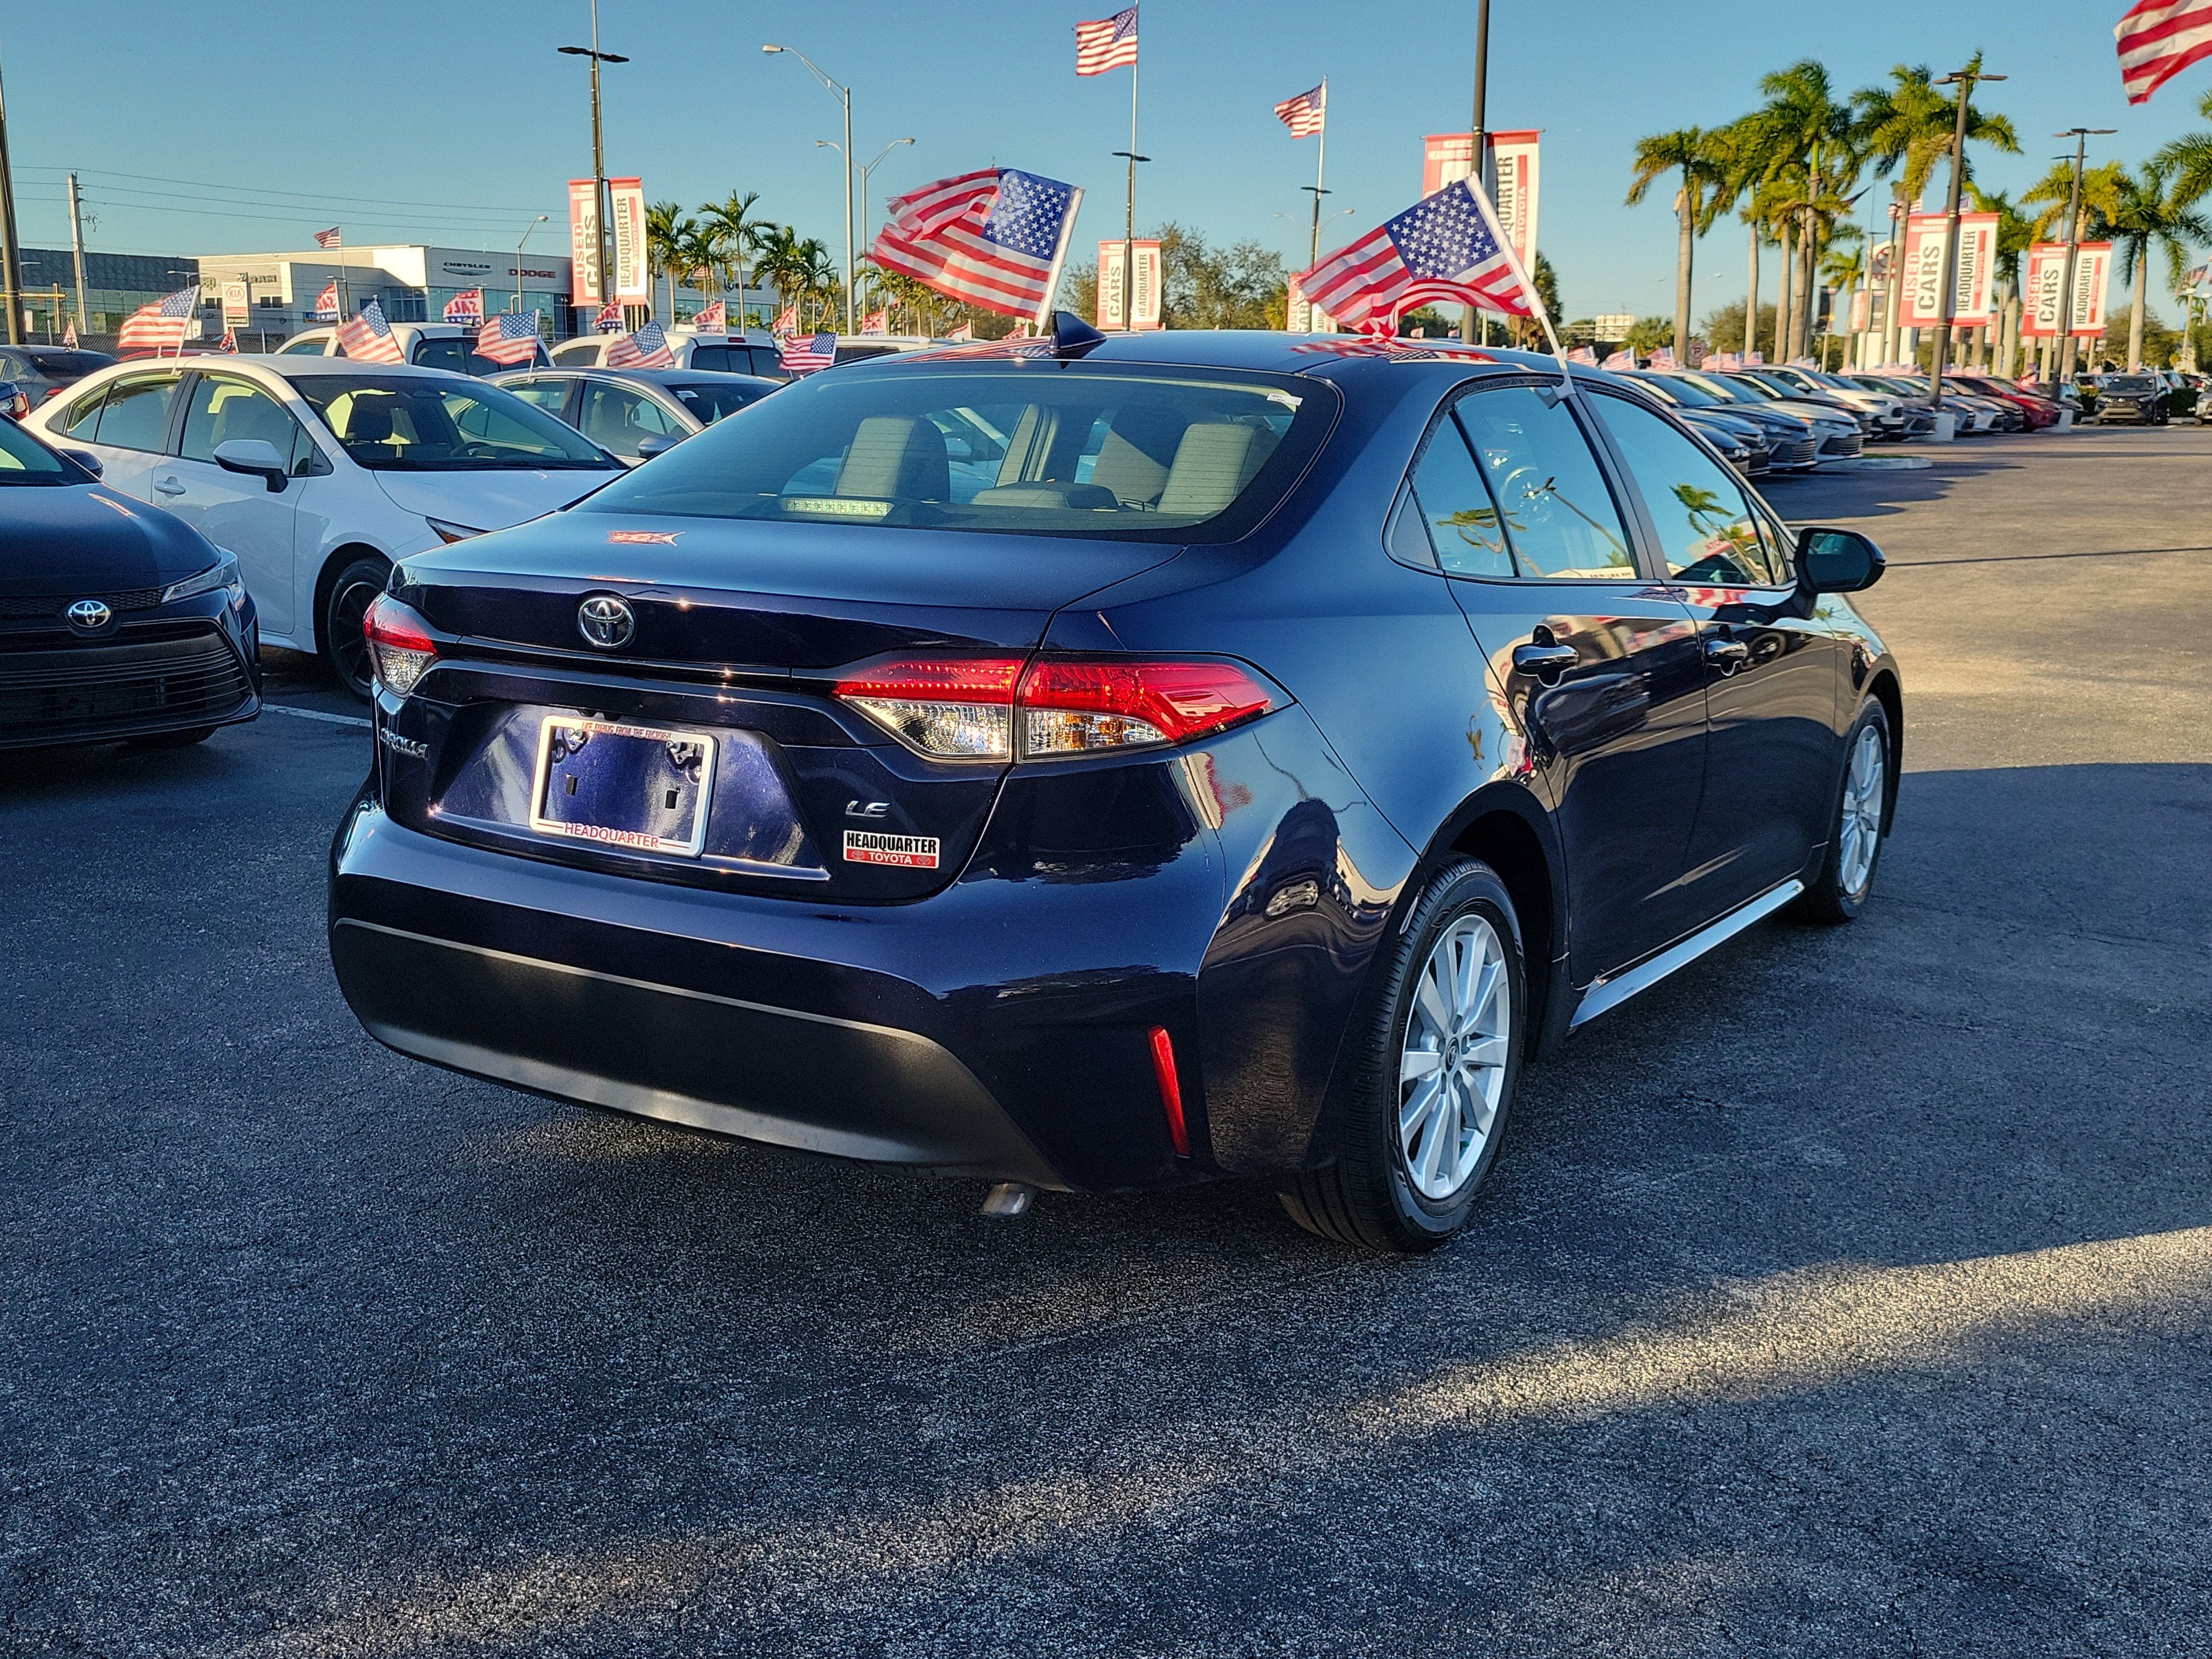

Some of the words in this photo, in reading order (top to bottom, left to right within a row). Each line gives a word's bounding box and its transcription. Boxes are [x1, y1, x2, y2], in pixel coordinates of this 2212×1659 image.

[1498, 156, 1513, 233] QUARTER
[1517, 187, 1527, 233] TOYOTA
[574, 224, 585, 275] USED
[585, 215, 598, 288] CARS
[617, 198, 631, 288] HEADQUARTER
[229, 290, 242, 298] KIA
[249, 275, 278, 284] RAM
[509, 268, 556, 278] DODGE
[1101, 273, 1109, 307] USED
[1110, 266, 1120, 317] CARS
[1139, 254, 1148, 317] HEADQUARTER
[1905, 255, 1920, 298] USED
[1918, 246, 1940, 309] CARS
[1957, 231, 1976, 311] HEADQUARTER
[2075, 257, 2092, 324] HEADQUARTER
[2027, 276, 2041, 313] USED
[2039, 269, 2058, 322] CARS
[845, 800, 890, 819] LE
[565, 824, 659, 848] HEADQUARTER
[847, 832, 936, 854] HEADQUARTER
[869, 852, 912, 865] TOYOTA
